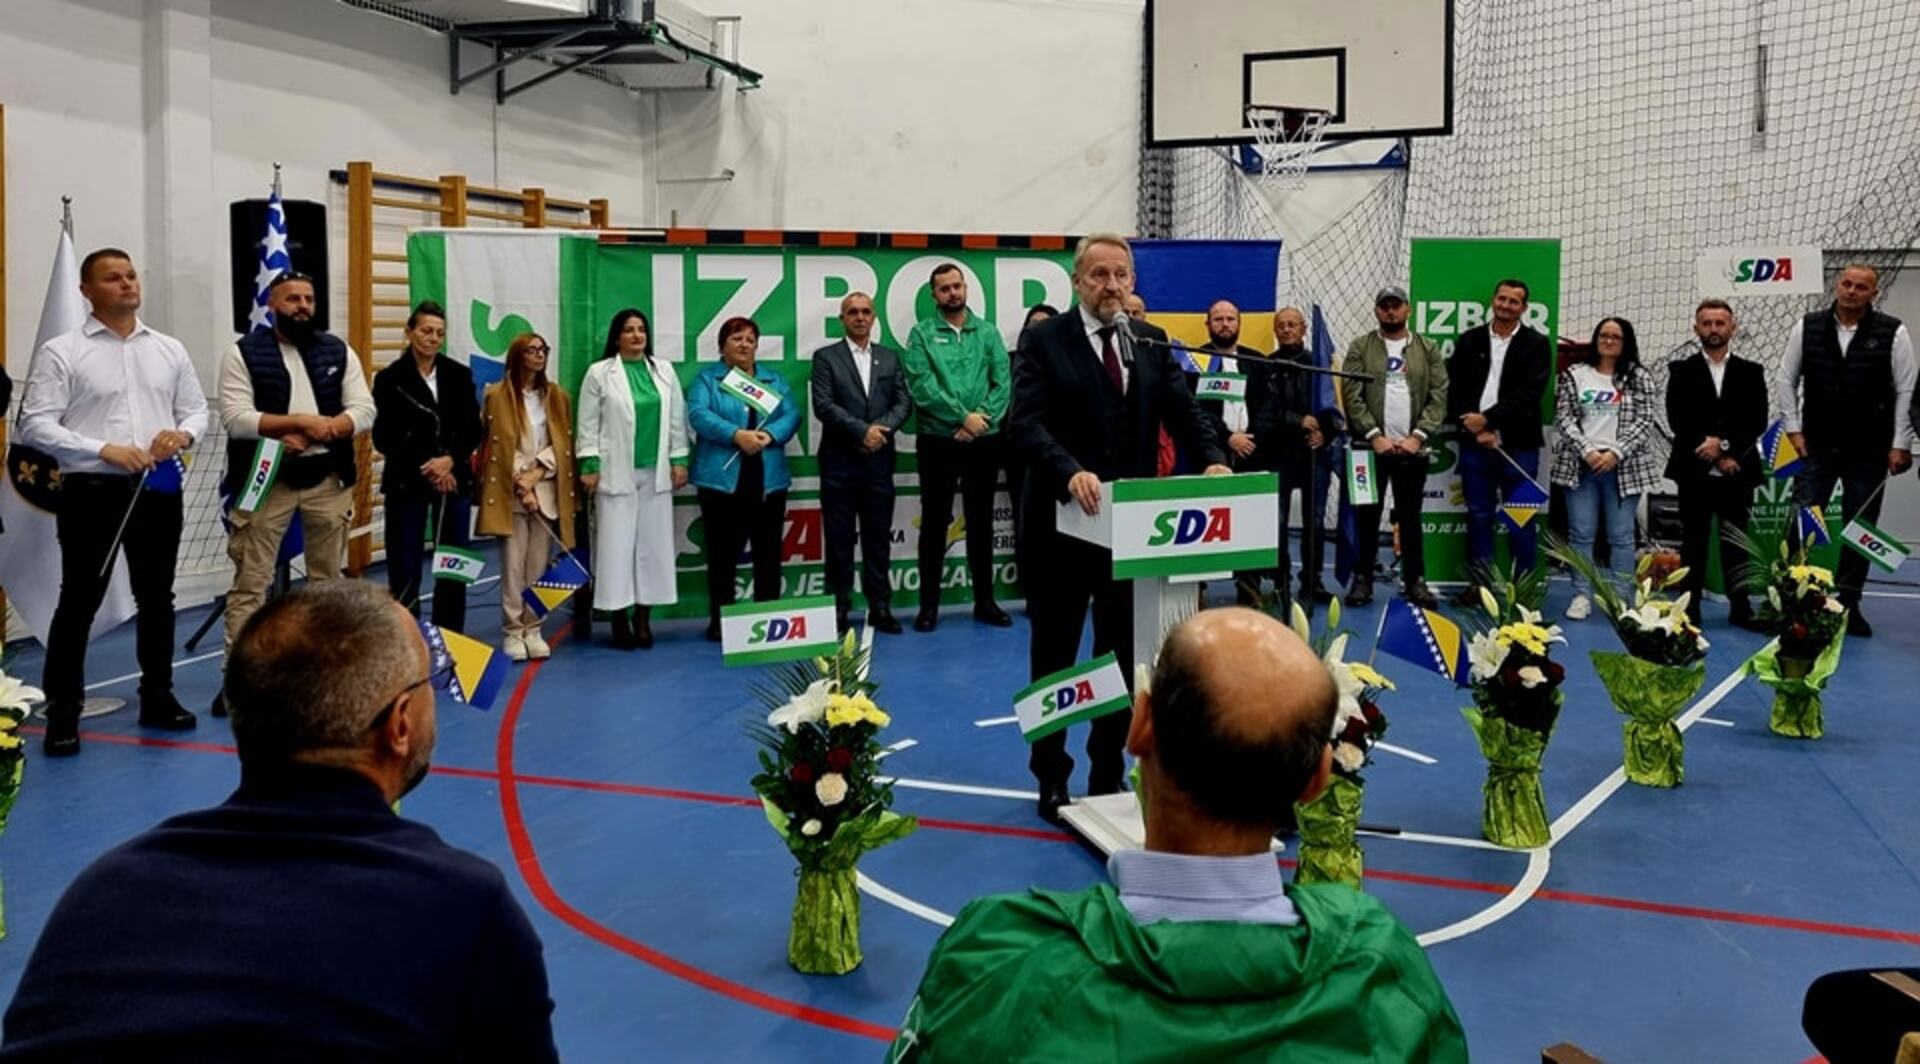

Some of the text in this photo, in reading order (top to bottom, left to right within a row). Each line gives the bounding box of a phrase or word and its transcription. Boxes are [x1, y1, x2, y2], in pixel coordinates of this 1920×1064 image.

[1735, 258, 1792, 283] SDA
[1415, 301, 1550, 334] IZBR
[735, 381, 764, 400] SDA
[1205, 380, 1230, 391] SDA
[252, 459, 271, 497] SDA
[1355, 465, 1368, 492] SDA
[1148, 507, 1231, 546] SDA
[1858, 533, 1892, 557] SDA
[793, 572, 826, 597] JE
[748, 615, 807, 643] SDA
[1041, 680, 1095, 717] SDA
